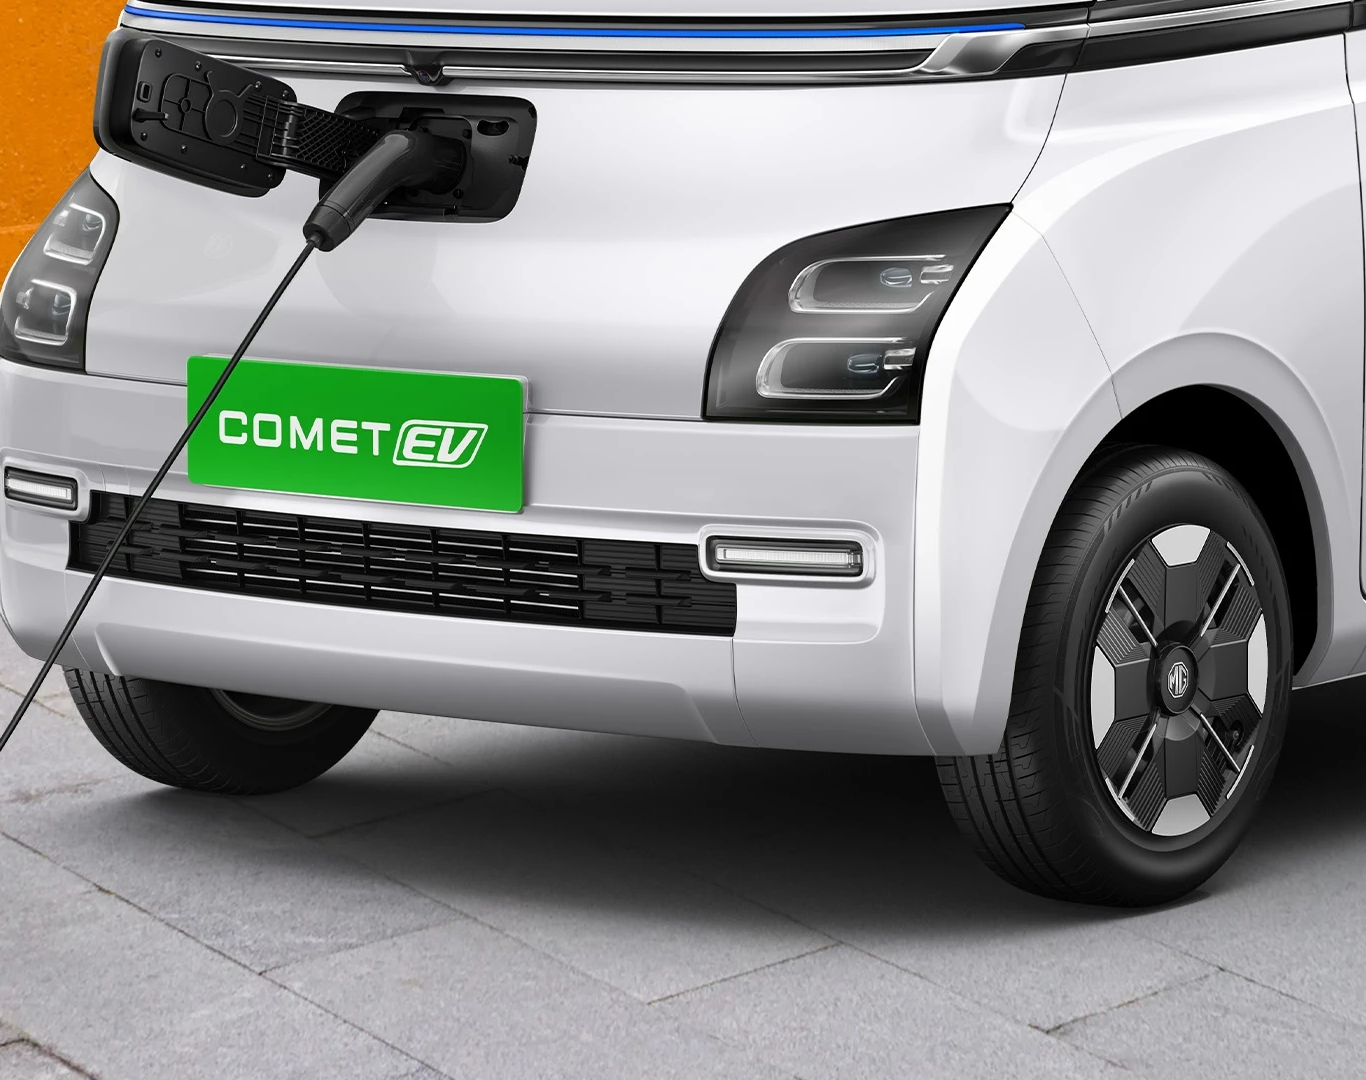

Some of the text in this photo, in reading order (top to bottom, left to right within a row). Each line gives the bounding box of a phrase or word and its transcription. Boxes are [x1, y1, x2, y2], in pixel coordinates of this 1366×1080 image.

[218, 409, 478, 463] COMET EV
[1169, 664, 1188, 695] MG
